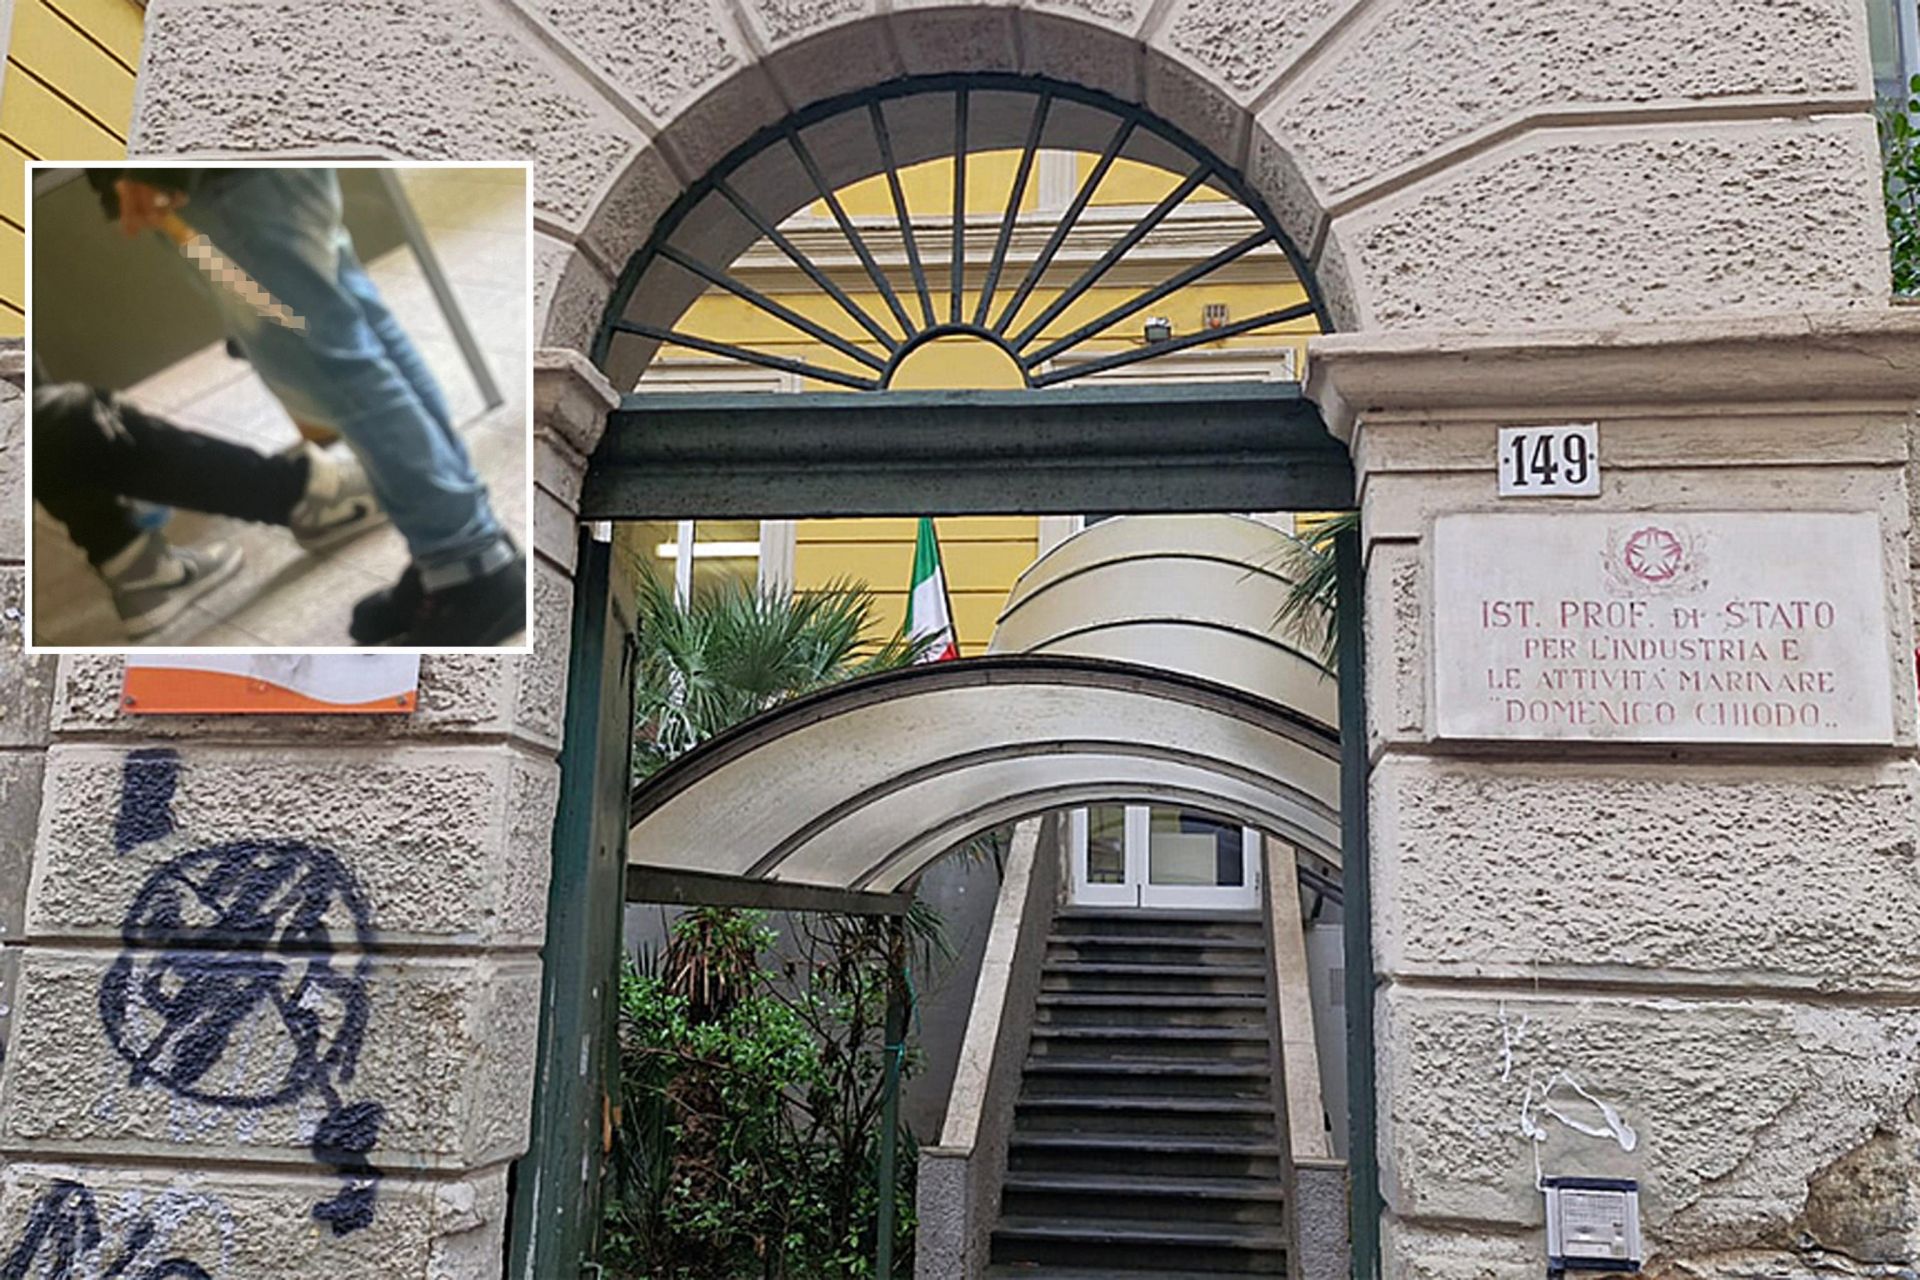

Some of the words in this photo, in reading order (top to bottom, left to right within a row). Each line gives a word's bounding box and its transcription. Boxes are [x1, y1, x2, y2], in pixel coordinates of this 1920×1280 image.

[1511, 433, 1589, 486] 149
[1481, 600, 1541, 629] IST.
[1560, 600, 1655, 629] PROF.
[1725, 600, 1836, 630] STATO
[1524, 637, 1577, 660] PER
[1591, 636, 1768, 662] L'INDUSTRIA
[1781, 638, 1800, 661] E
[1487, 668, 1522, 690] LE
[1678, 670, 1836, 693] MARINARE
